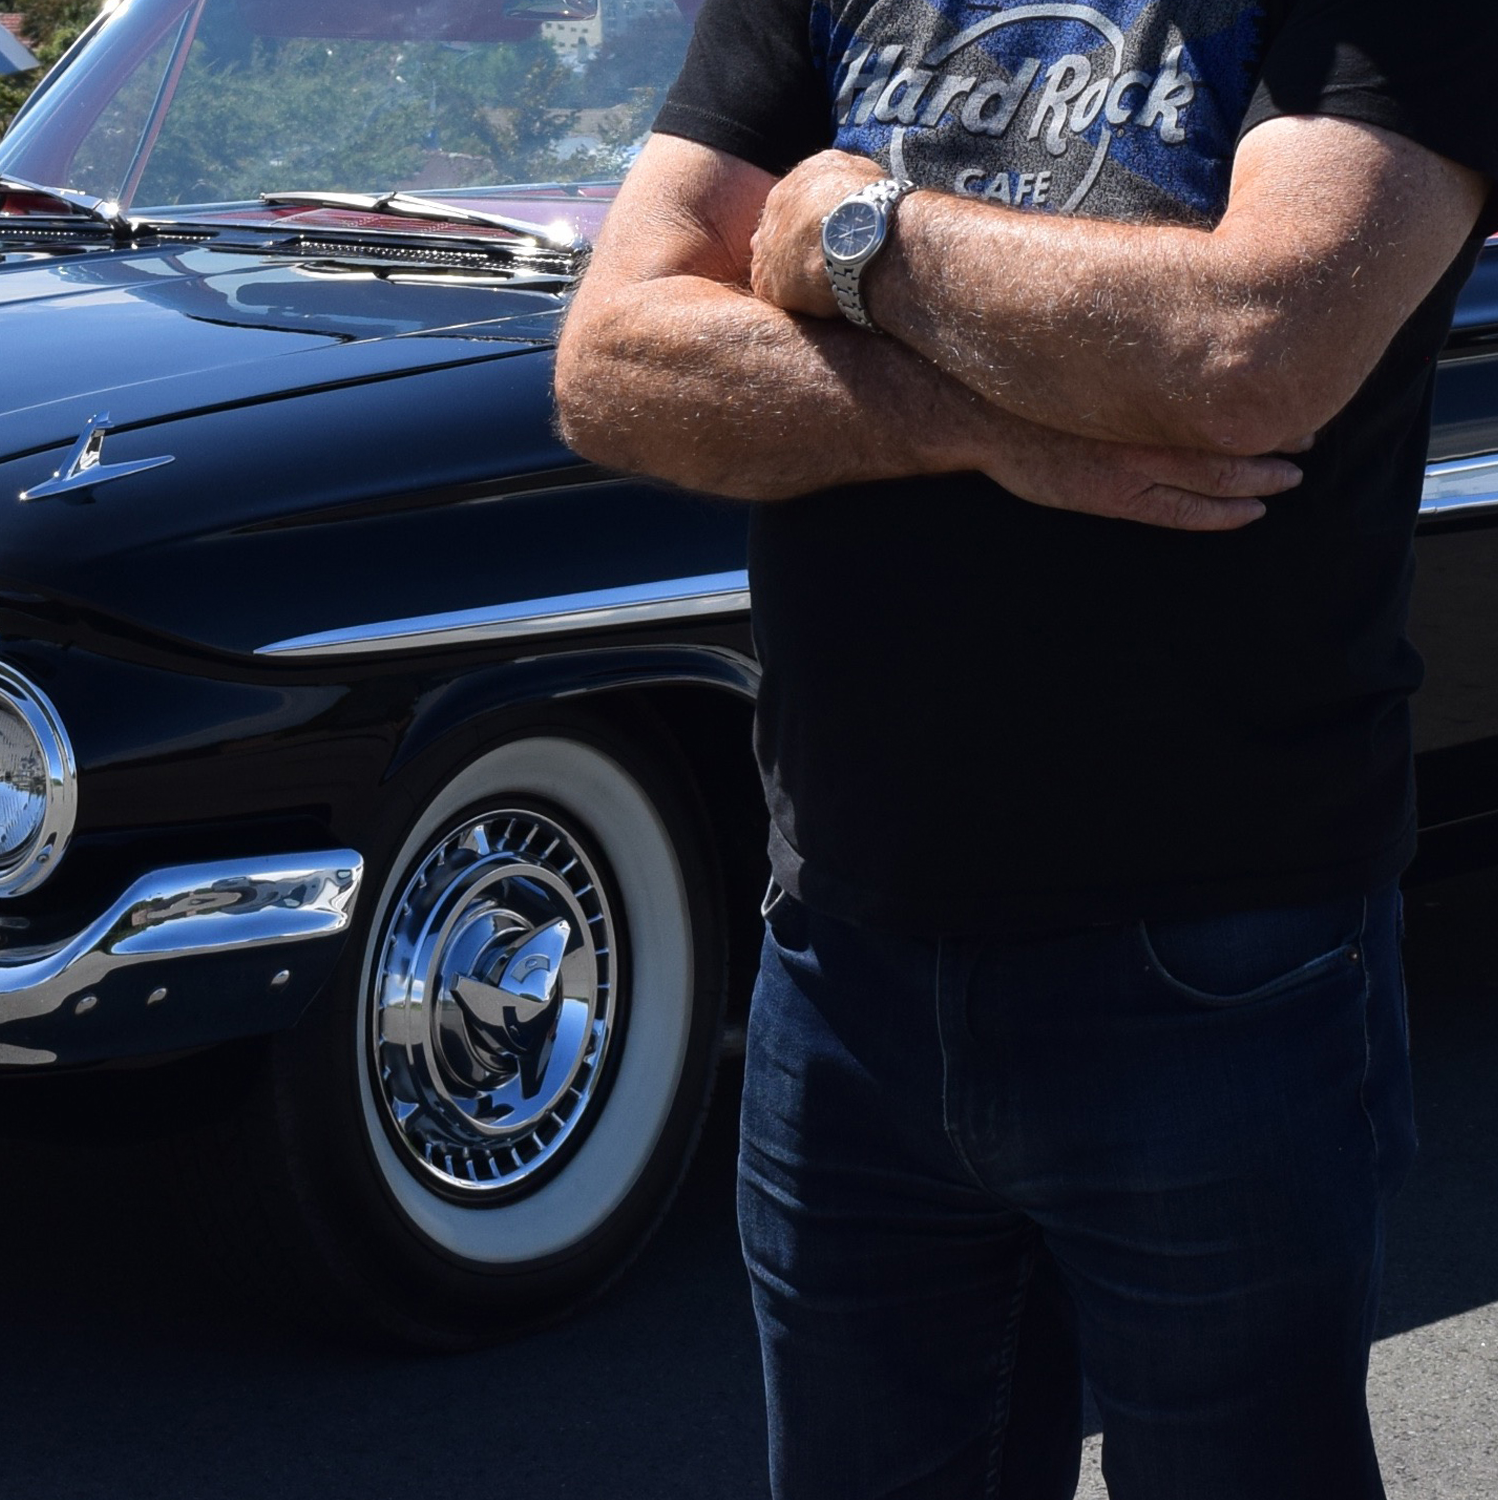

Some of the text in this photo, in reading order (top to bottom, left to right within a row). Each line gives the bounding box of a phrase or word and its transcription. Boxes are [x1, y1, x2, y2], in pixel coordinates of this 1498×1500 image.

[836, 43, 1196, 157] Hard Rock
[954, 167, 1052, 205] CAFE
